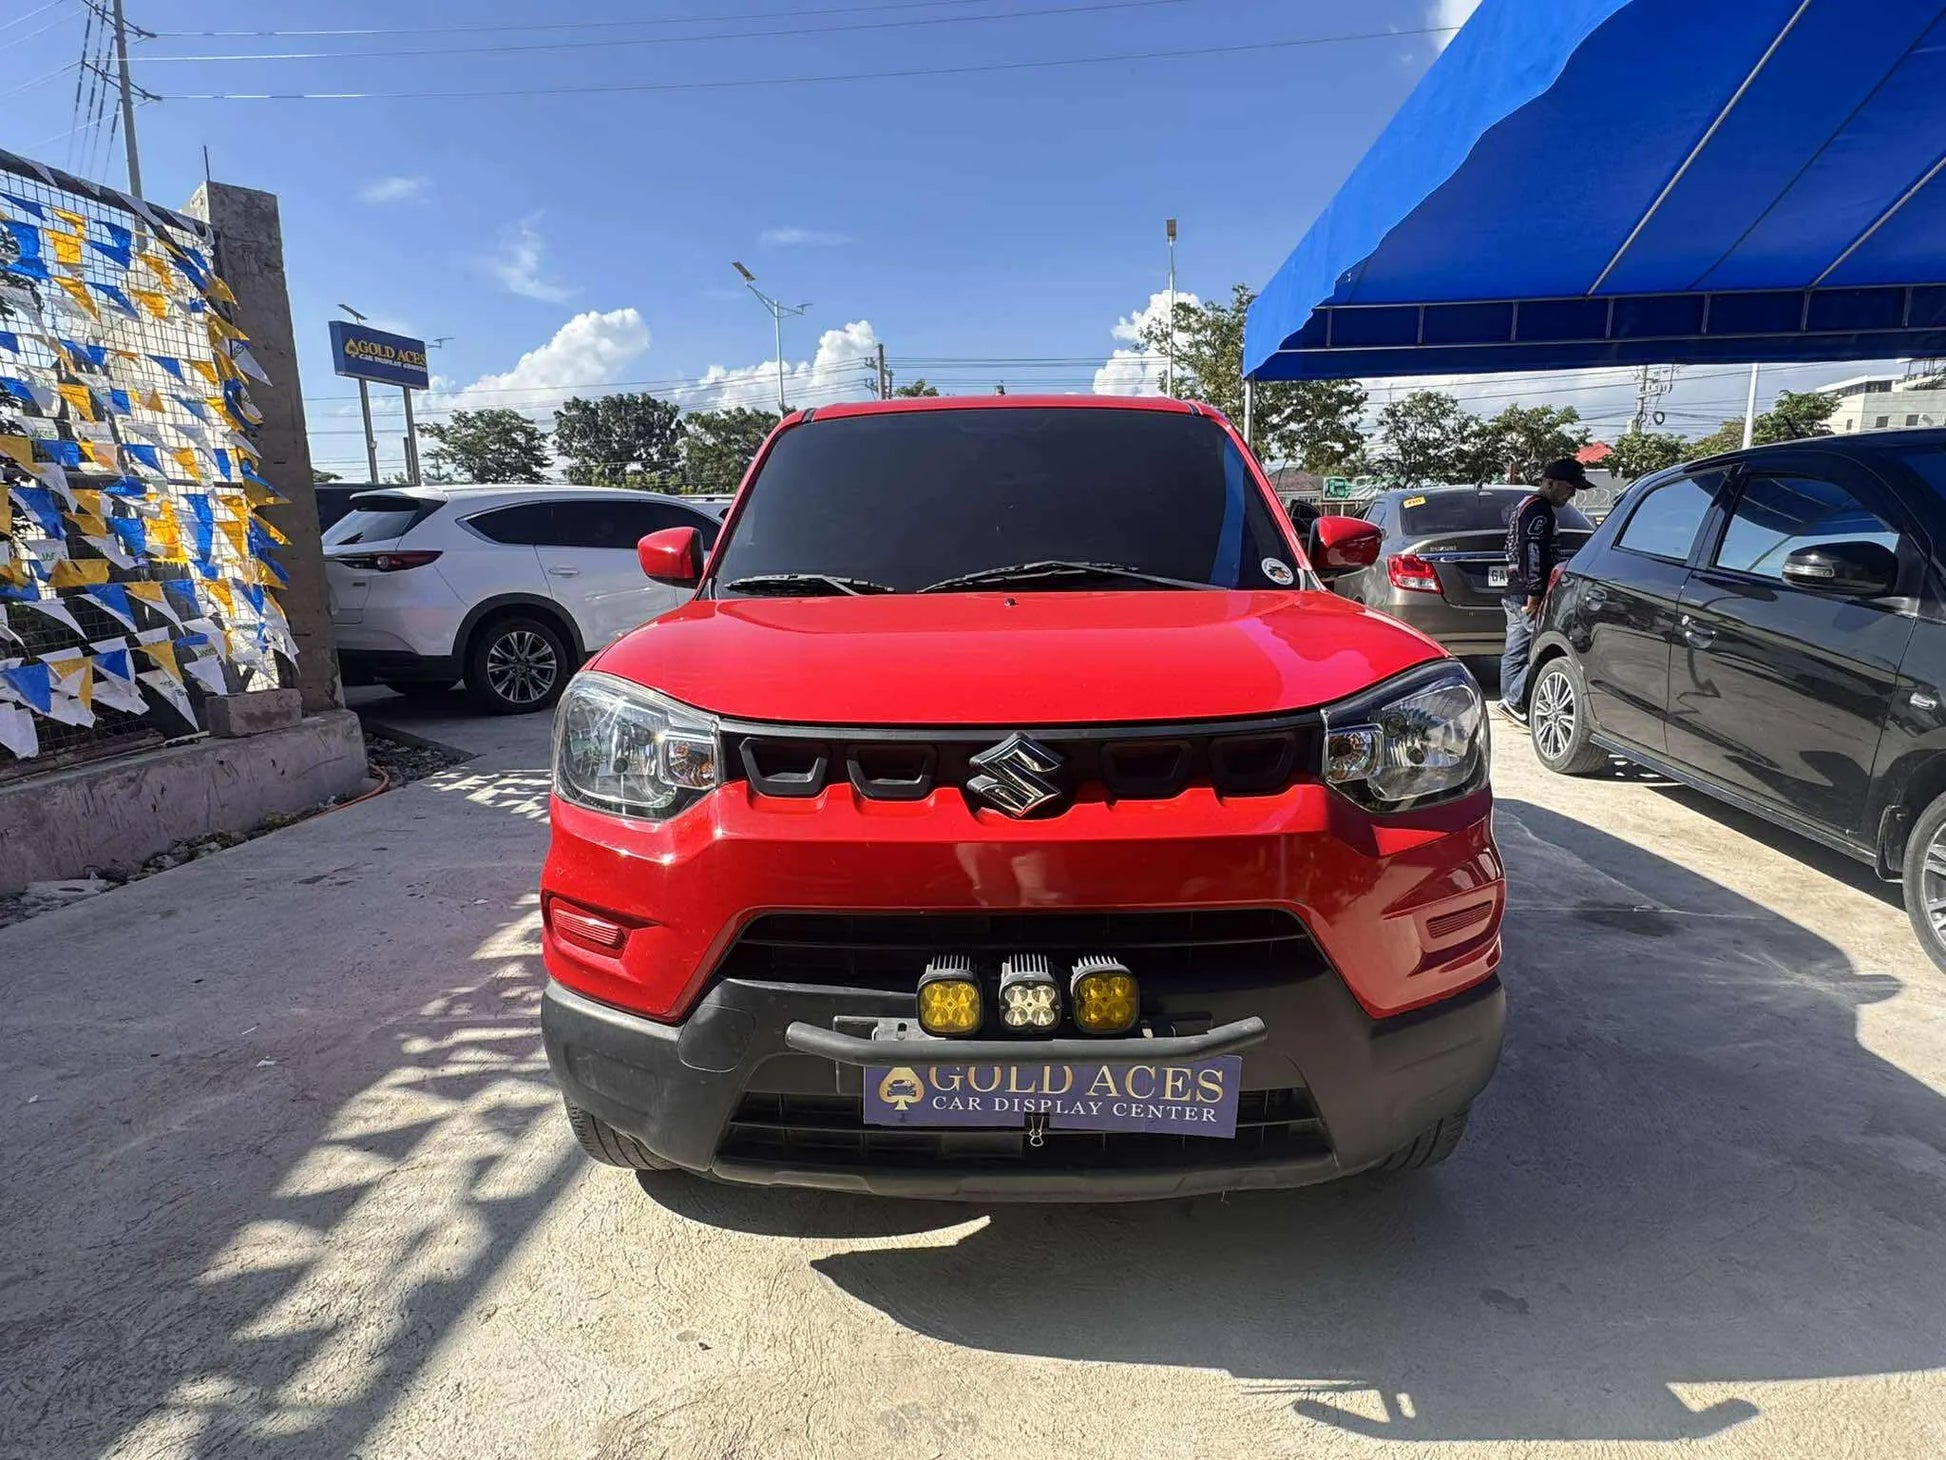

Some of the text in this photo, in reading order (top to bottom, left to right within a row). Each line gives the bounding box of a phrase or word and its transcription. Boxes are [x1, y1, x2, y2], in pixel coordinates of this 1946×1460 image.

[358, 340, 426, 366] GOLD ACES
[928, 1065, 1224, 1104] GOLD ACES
[932, 1096, 1217, 1122] CAR DISPLAY CENTER
